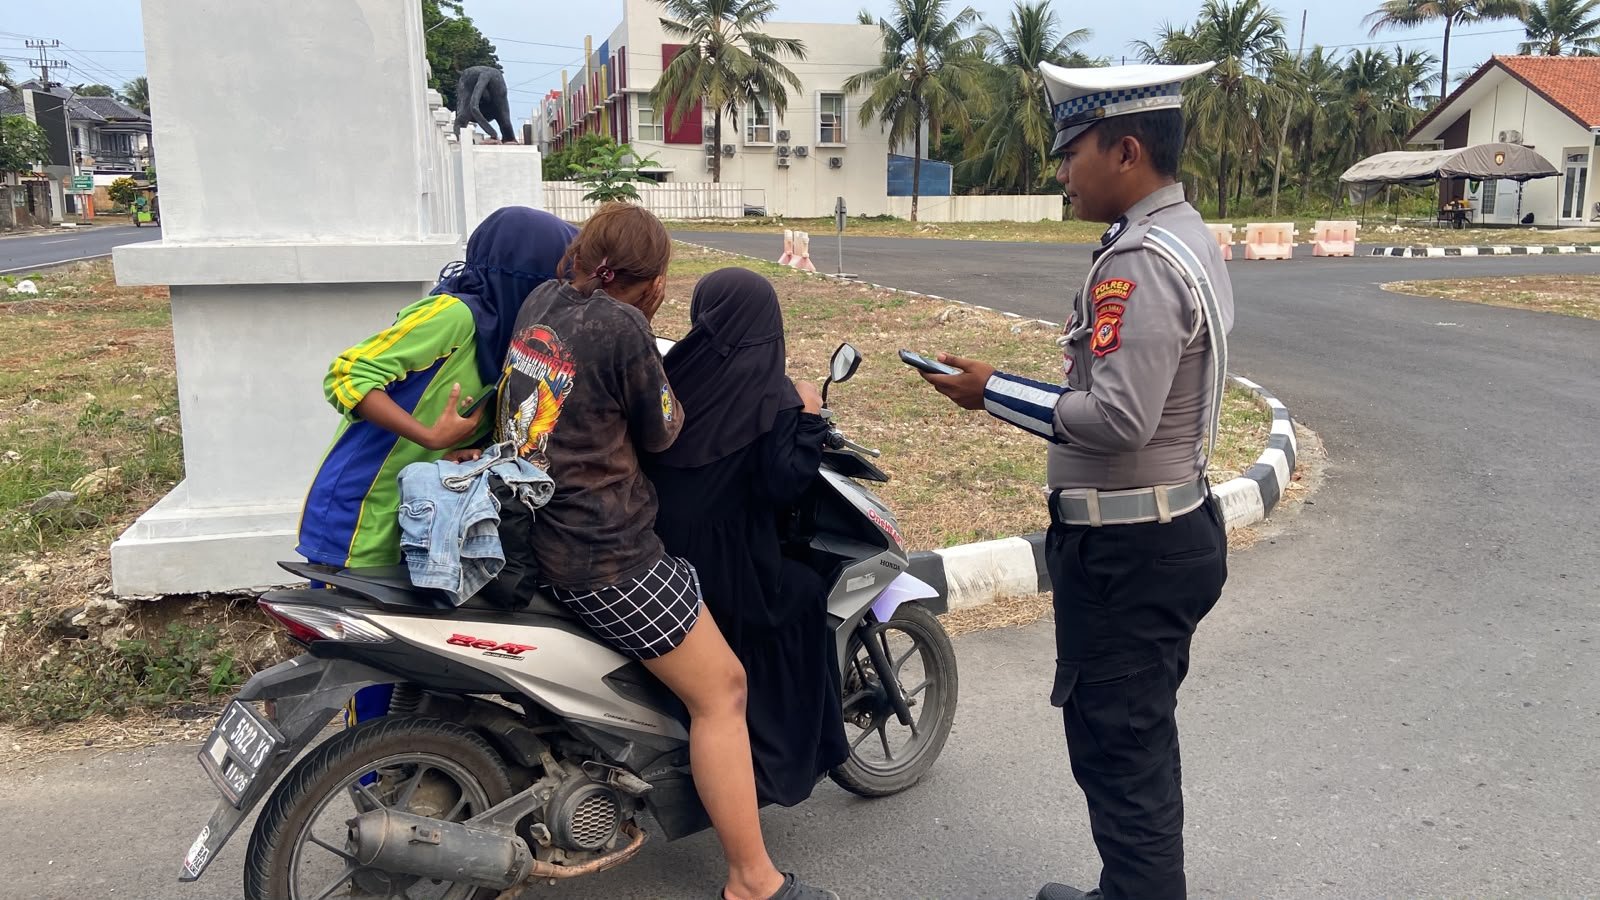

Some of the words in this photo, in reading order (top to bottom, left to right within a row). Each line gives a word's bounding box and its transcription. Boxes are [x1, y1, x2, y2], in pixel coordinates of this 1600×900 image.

[1095, 281, 1130, 295] POLRES
[880, 560, 901, 572] HONDA
[221, 708, 237, 732] Z
[230, 717, 258, 755] 5622
[249, 739, 270, 768] YS
